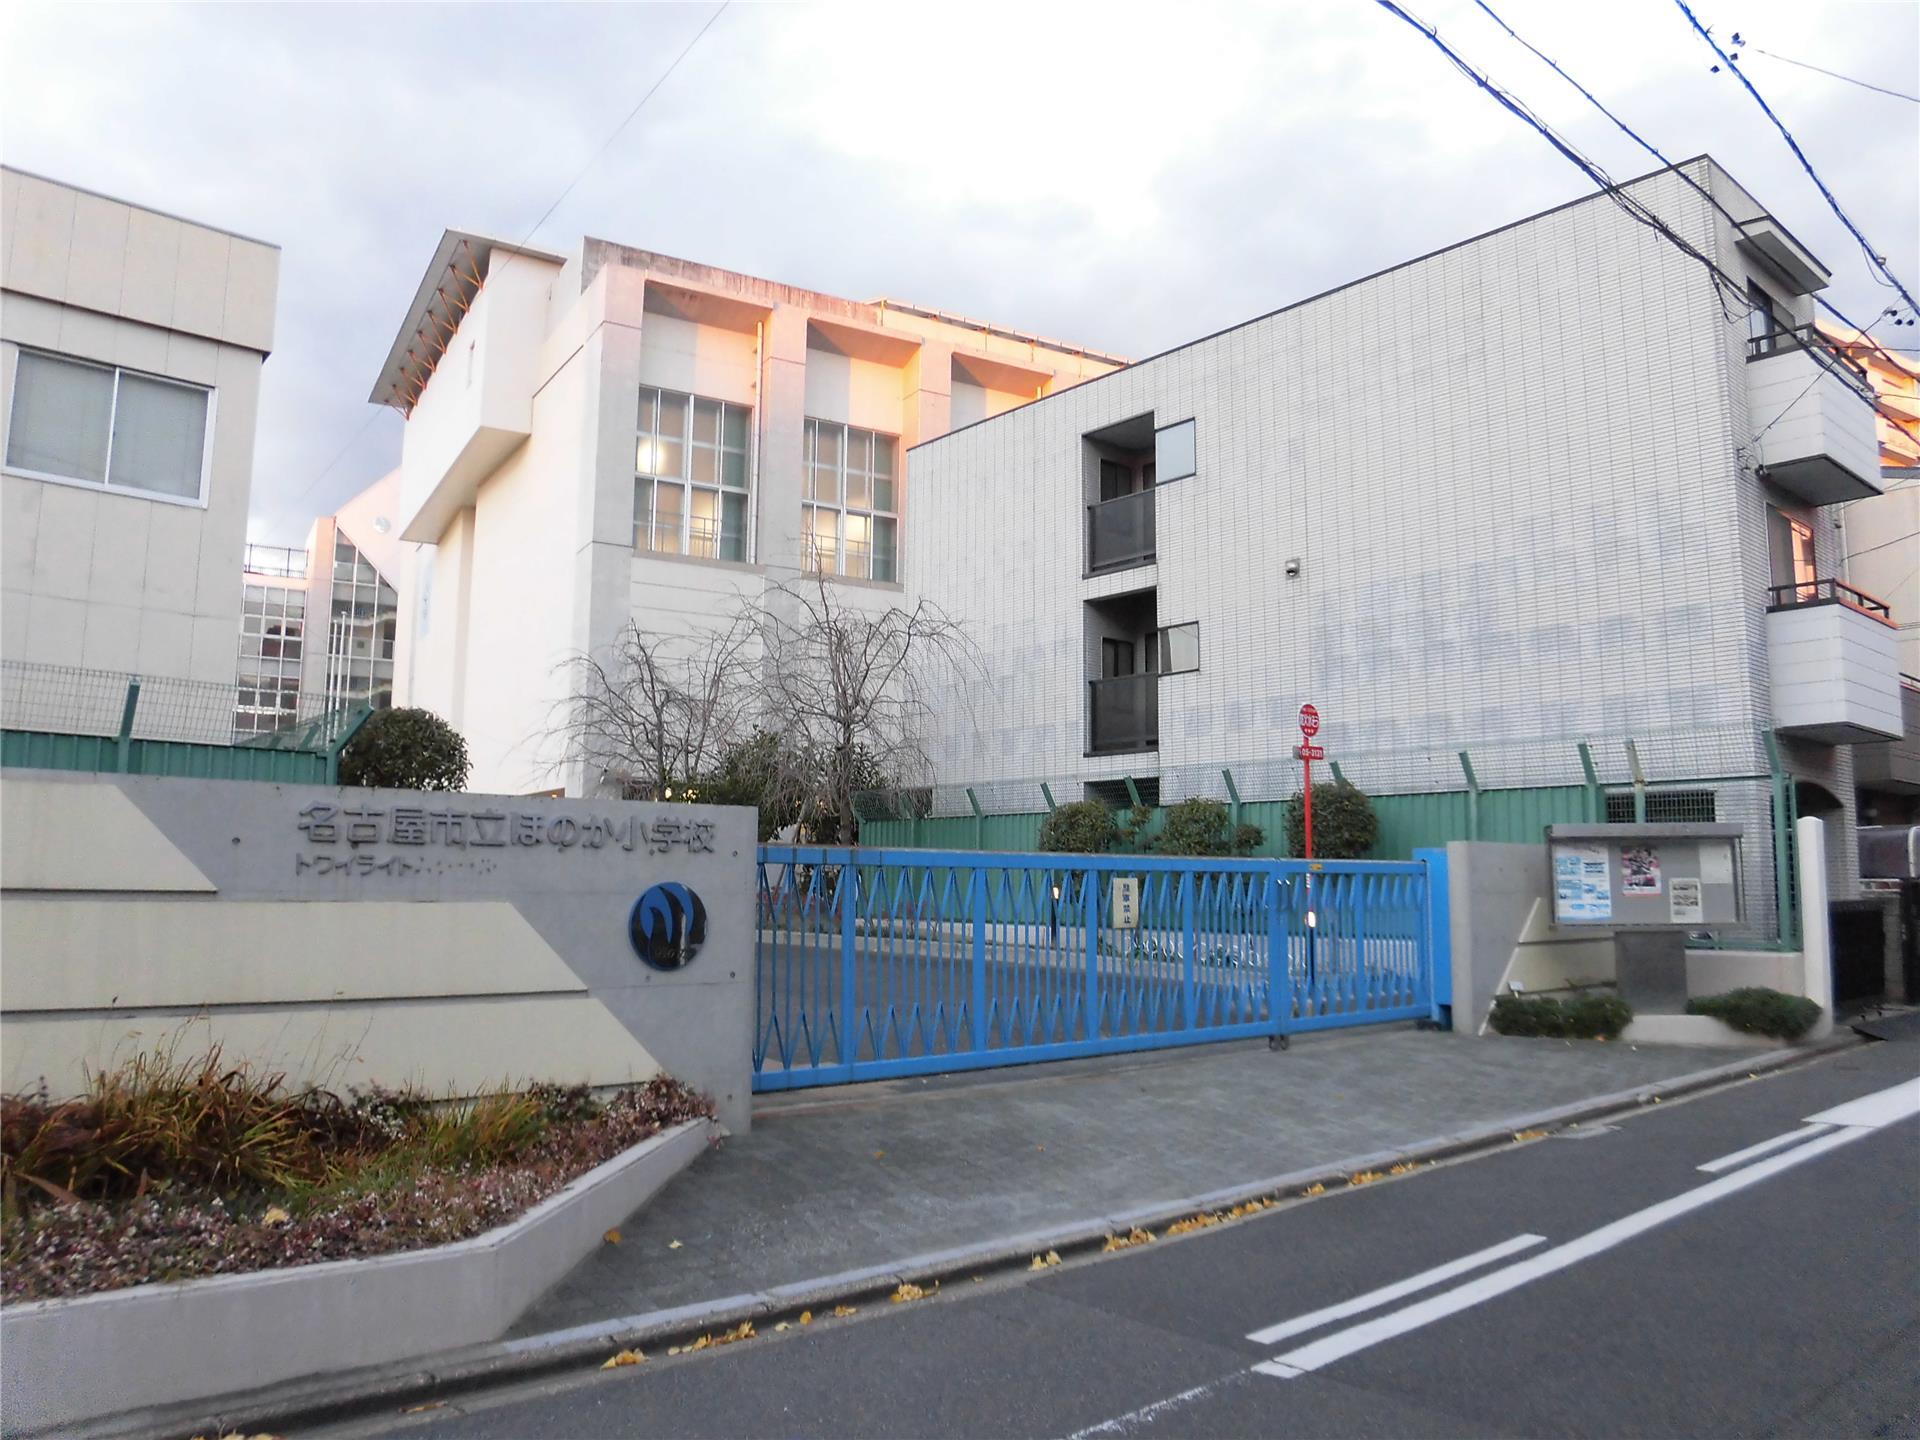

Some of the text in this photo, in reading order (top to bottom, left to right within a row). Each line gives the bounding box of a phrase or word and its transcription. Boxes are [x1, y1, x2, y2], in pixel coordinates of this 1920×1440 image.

[298, 804, 716, 853] 名古屋市立ほのか小学校
